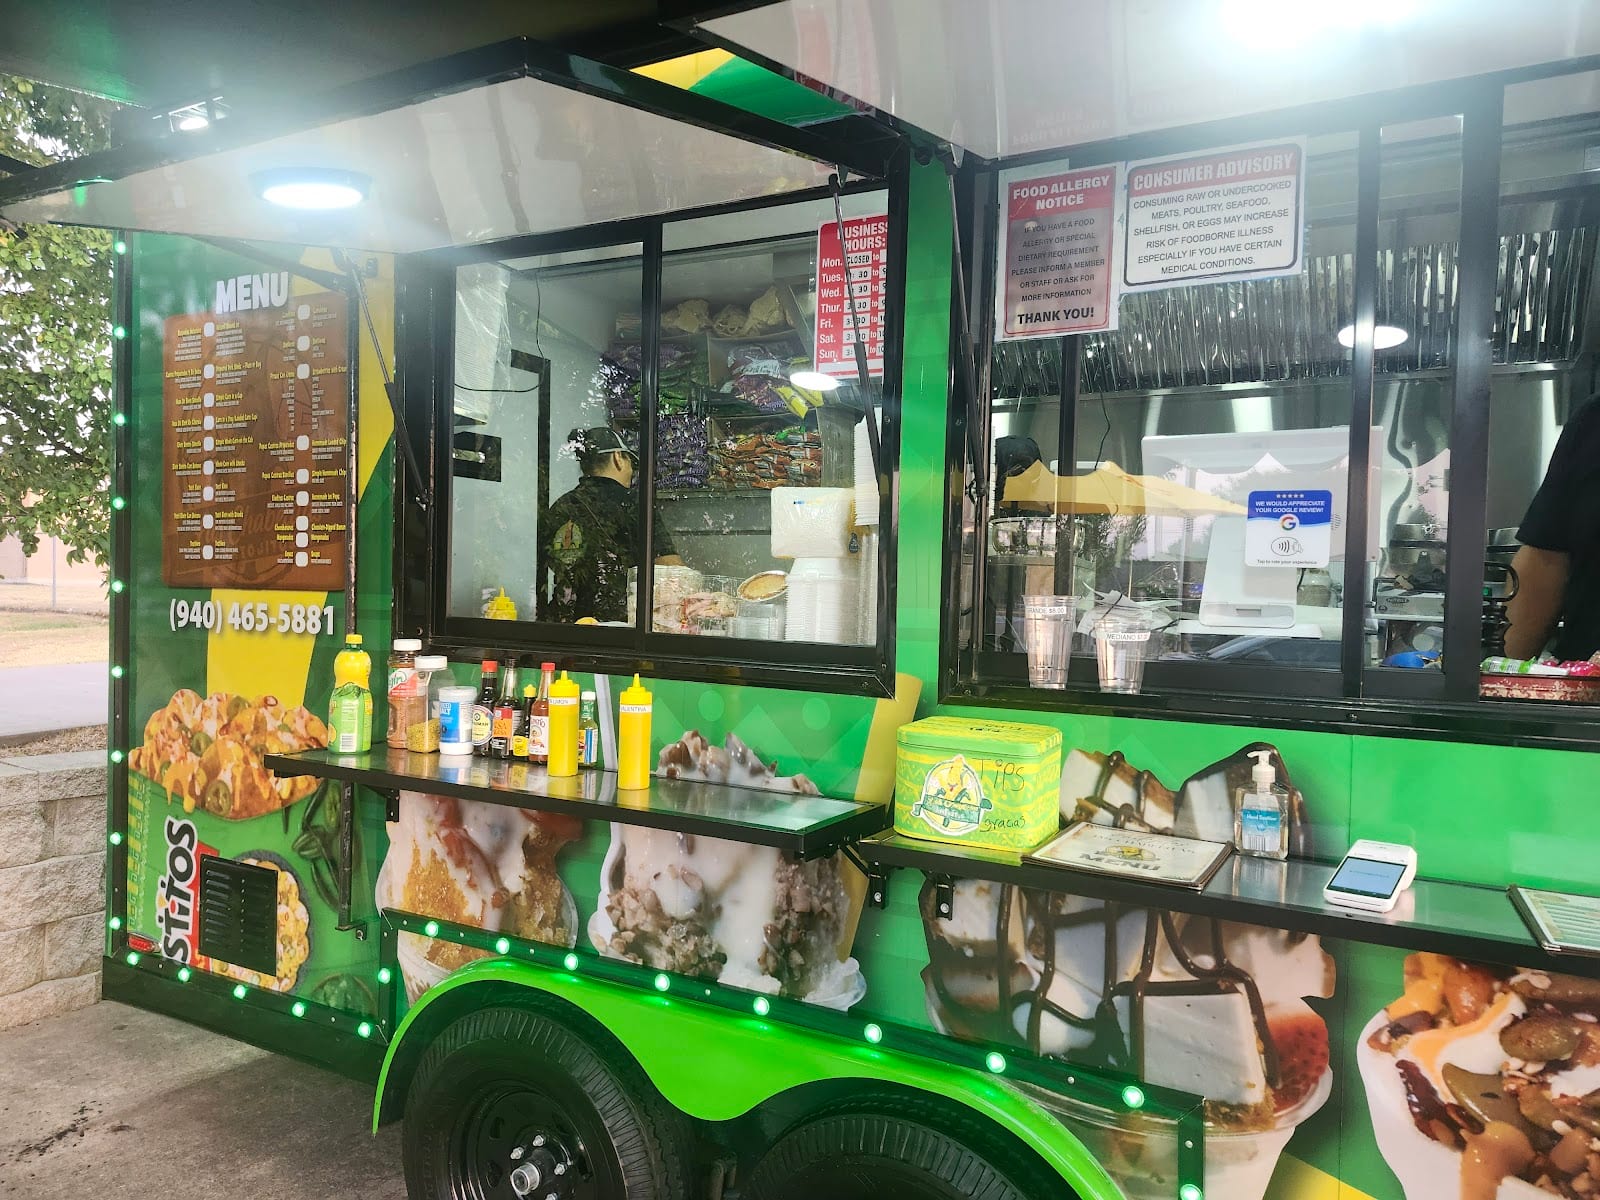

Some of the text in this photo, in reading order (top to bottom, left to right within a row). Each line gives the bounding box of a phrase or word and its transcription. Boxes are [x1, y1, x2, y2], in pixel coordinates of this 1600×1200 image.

[1133, 152, 1295, 191] CONSUMER ADVISORY
[1013, 175, 1110, 200] FOOD ALLERGY
[1133, 180, 1292, 210] CONSUMING RAW OR UNDERCOOKED
[1036, 193, 1085, 210] NOTICE
[1183, 203, 1224, 216] POULTRY,
[1024, 226, 1030, 234] IF
[1031, 224, 1047, 233] YOU
[1048, 222, 1066, 231] HAVE
[1074, 218, 1095, 227] FOOD
[1182, 221, 1196, 230] OR
[1197, 217, 1222, 228] EGGS
[1223, 214, 1242, 225] MAY
[1244, 208, 1289, 222] INCREASE
[845, 235, 886, 252] HOURS:
[1022, 232, 1097, 248] ALLERGY OR SPECIAL
[1146, 225, 1274, 249] RISK OF FOODBORNE ILLNESS
[1018, 245, 1099, 262] DIETARY REQUIREMENT
[1138, 239, 1282, 264] ESPECIALLY IF YOU HAVE CERTAIN
[822, 257, 843, 268] Mon.
[847, 254, 870, 265] CLOSED
[1011, 258, 1105, 276] PLEASE INFORM A MEMBER
[1161, 256, 1256, 275] MEDICAL CONDITIONS.
[821, 273, 844, 283] Tues.
[1019, 273, 1095, 289] OR STAFF OR ASK FOR
[216, 271, 289, 315] MENU
[821, 287, 842, 298] Wed.
[872, 284, 878, 292] to
[1021, 288, 1092, 302] MORE INFORMATION
[821, 303, 842, 313] Thur.
[1017, 306, 1094, 325] THANK YOU!
[820, 318, 834, 329] Fri.
[870, 315, 877, 323] to
[819, 334, 836, 344] Sat.
[870, 330, 877, 338] to
[819, 349, 838, 359] Sun.
[1281, 516, 1297, 531] G
[169, 598, 334, 637] (940) 465-5881
